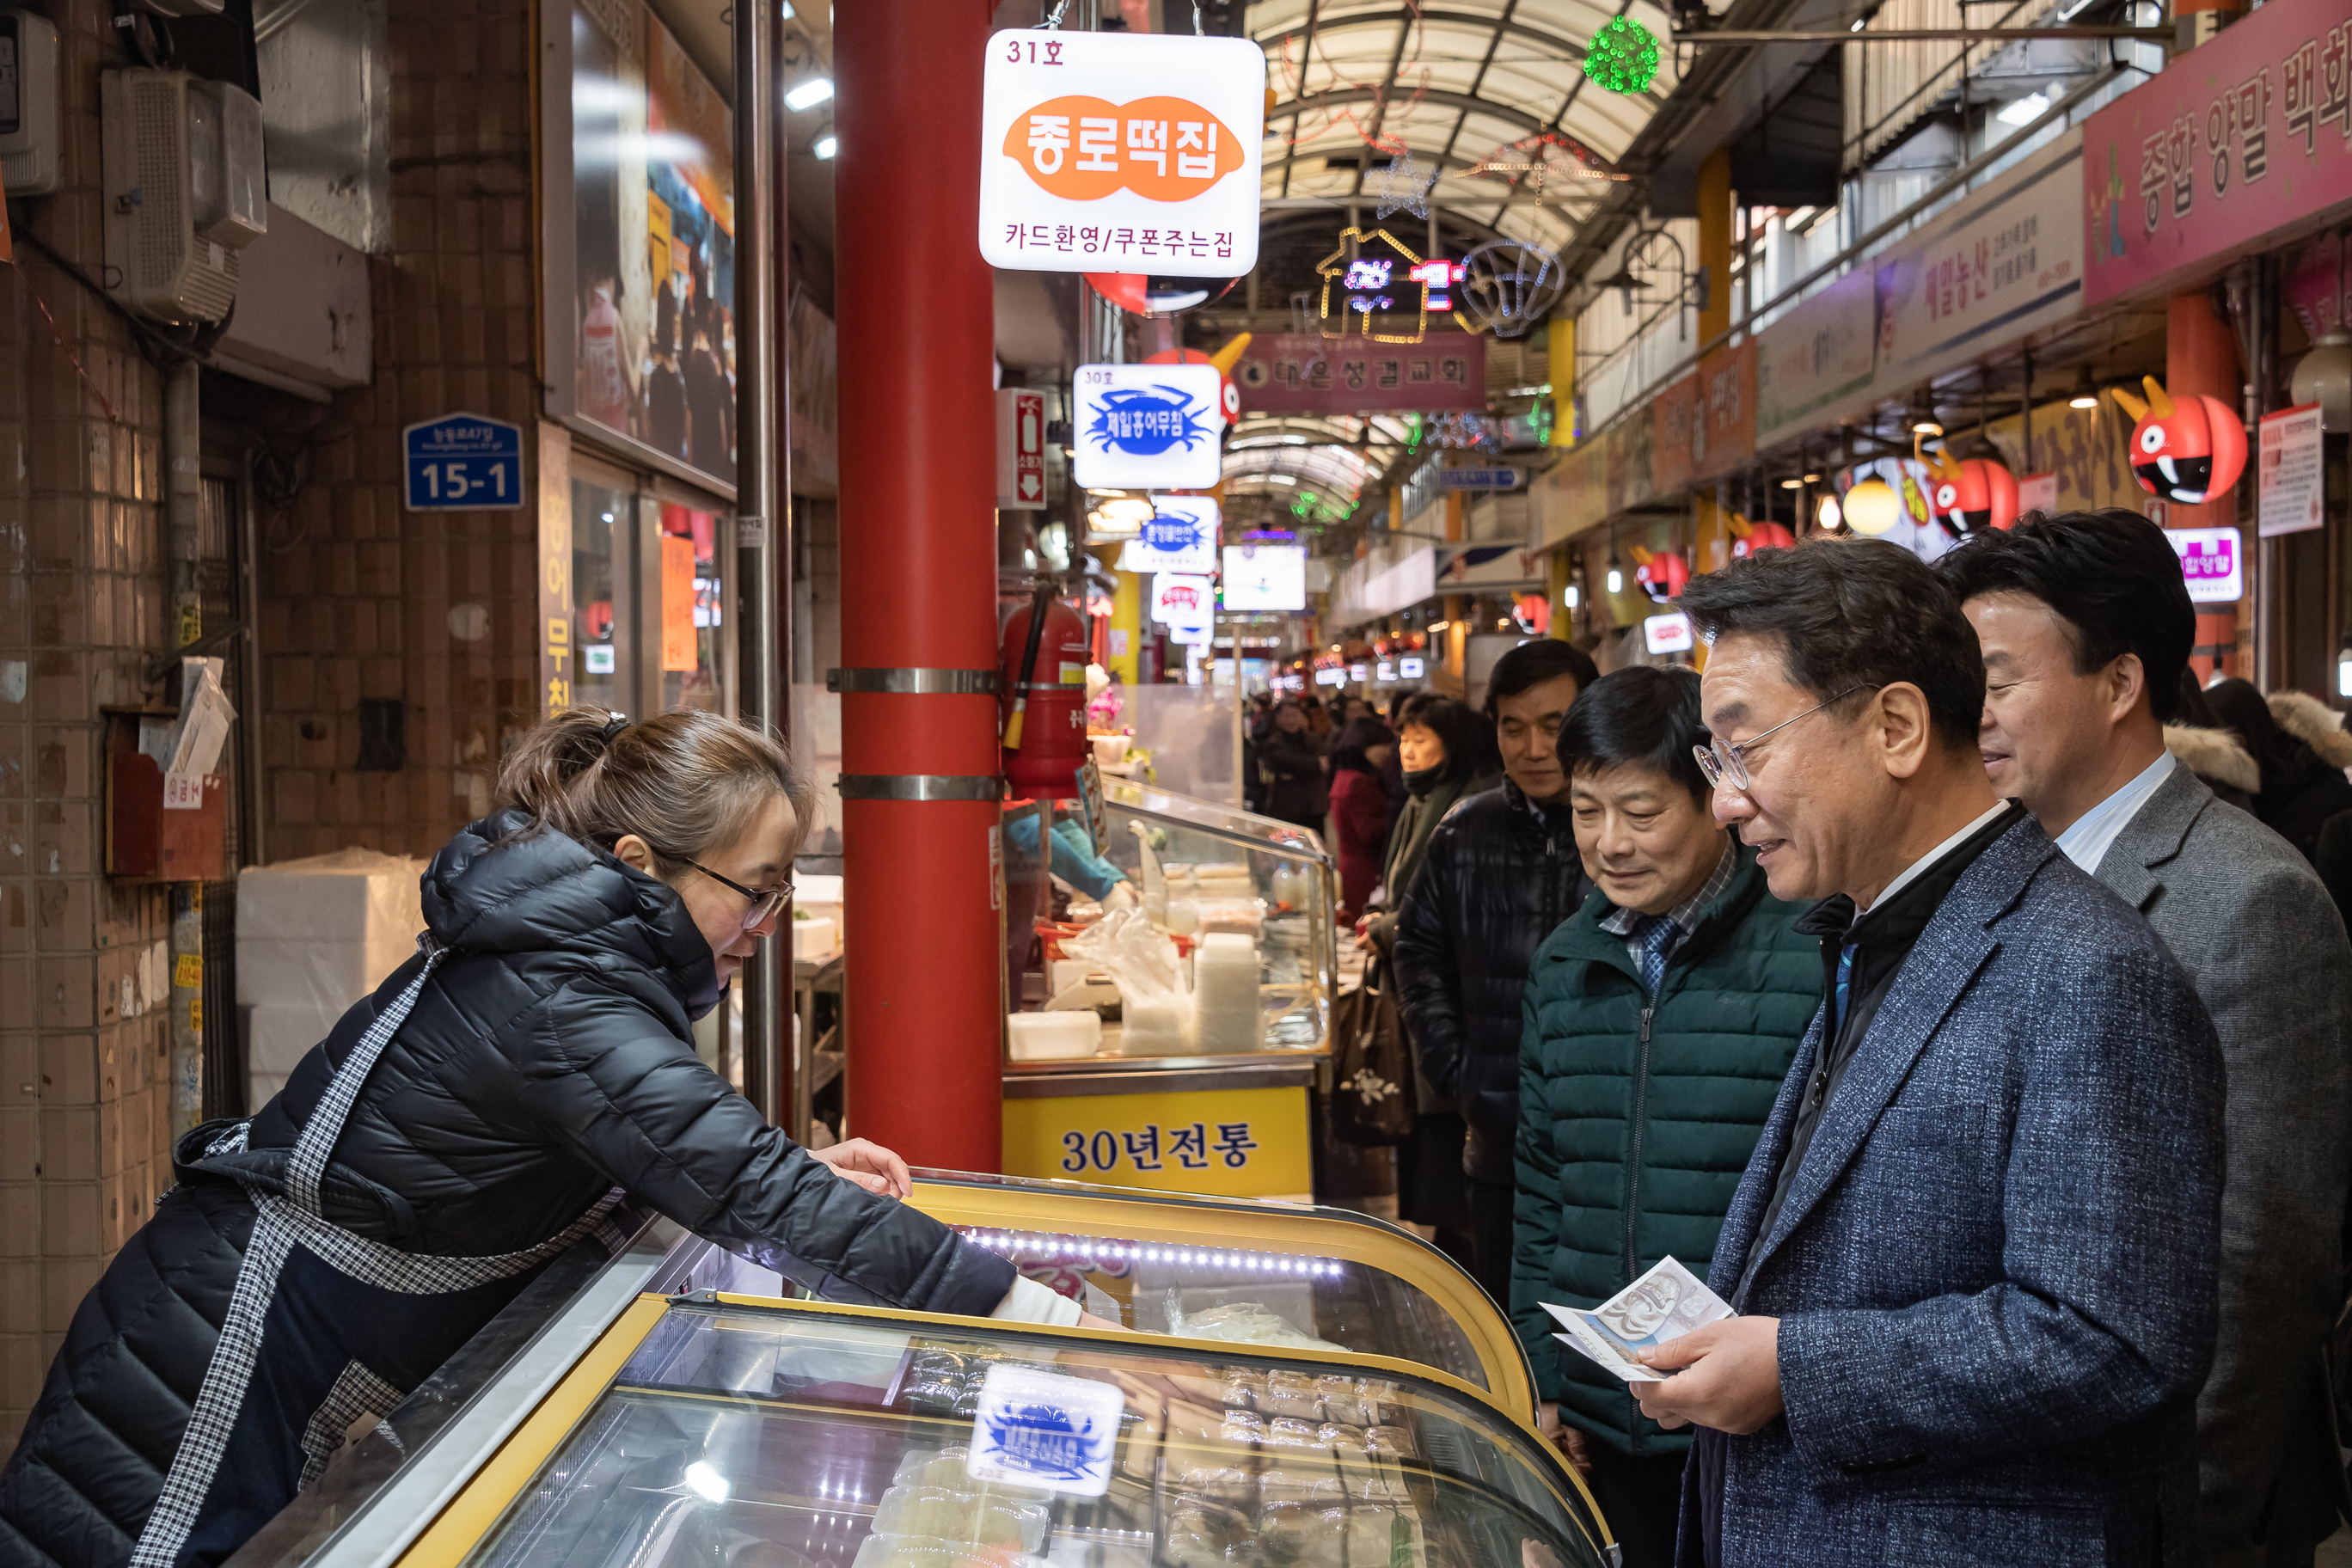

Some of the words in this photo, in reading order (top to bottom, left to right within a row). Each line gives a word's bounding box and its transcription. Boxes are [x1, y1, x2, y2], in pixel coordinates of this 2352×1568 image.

[1007, 40, 1063, 66] 31호
[1027, 114, 1218, 180] 종로떡집
[2140, 111, 2198, 234] 종합
[2206, 66, 2274, 199] 양말
[1005, 223, 1233, 258] 카드환영/쿠폰주는집
[1085, 371, 1114, 385] 30호
[1106, 411, 1184, 439] 제일홍어무침
[421, 462, 505, 499] 15-1
[2184, 554, 2230, 575] 합양말
[1062, 1122, 1258, 1172] 30년전통
